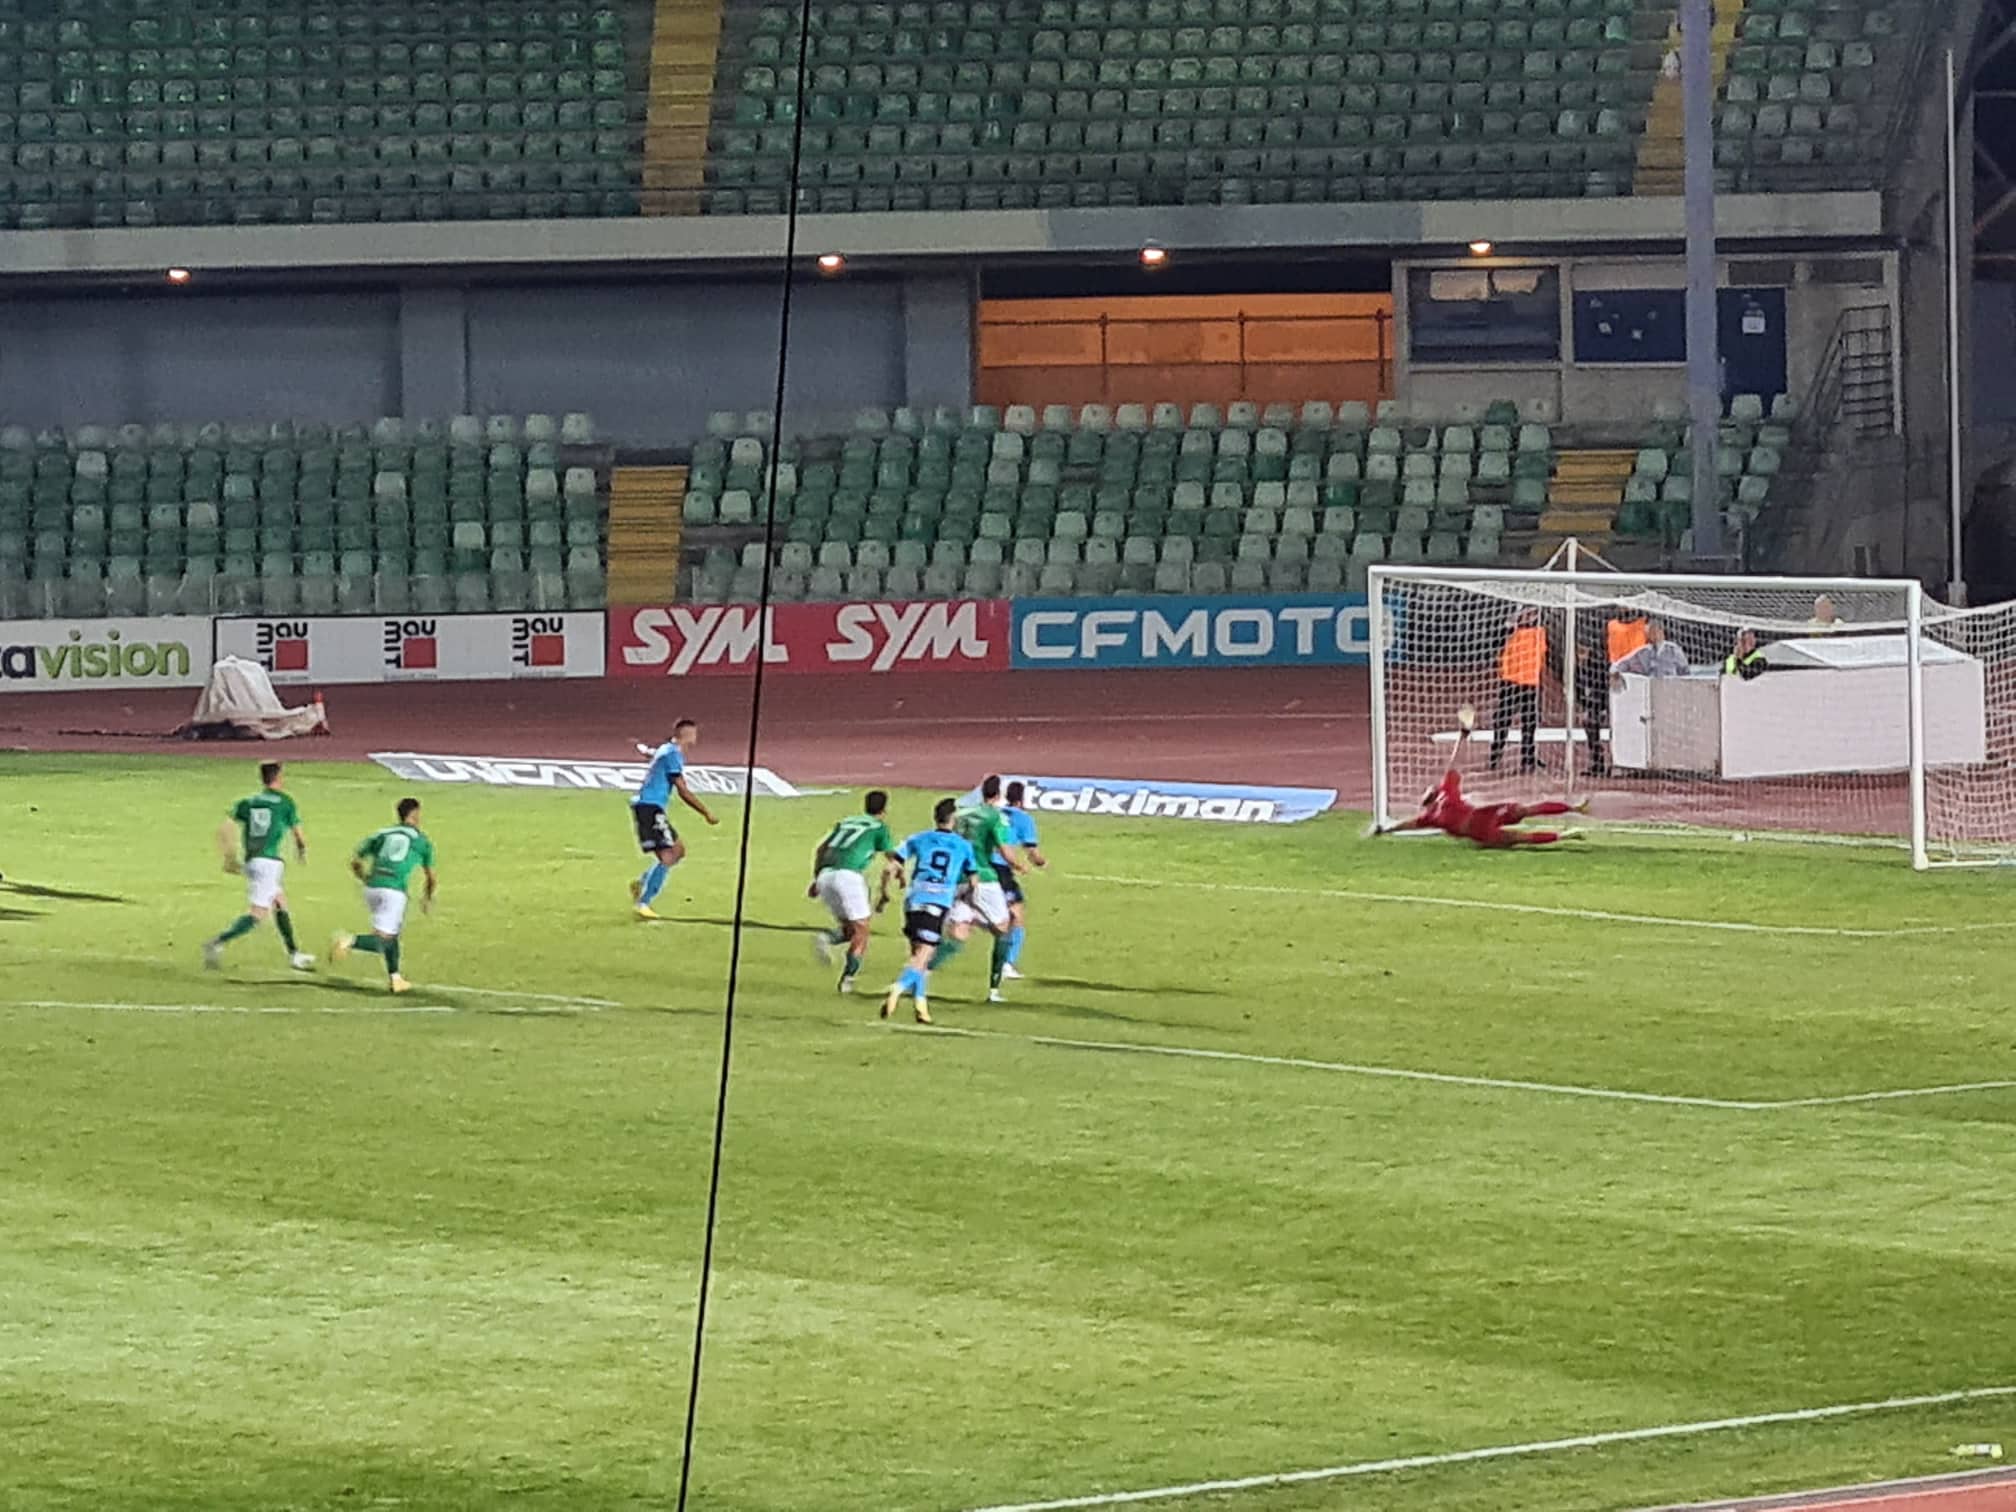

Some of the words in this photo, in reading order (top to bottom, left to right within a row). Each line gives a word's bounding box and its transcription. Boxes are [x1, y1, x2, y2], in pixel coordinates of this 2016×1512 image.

[0, 629, 190, 679] avision
[622, 607, 789, 675] SYM
[825, 602, 989, 672] SYM
[1021, 607, 1394, 659] CFMOTO
[1003, 780, 1275, 821] toiximan
